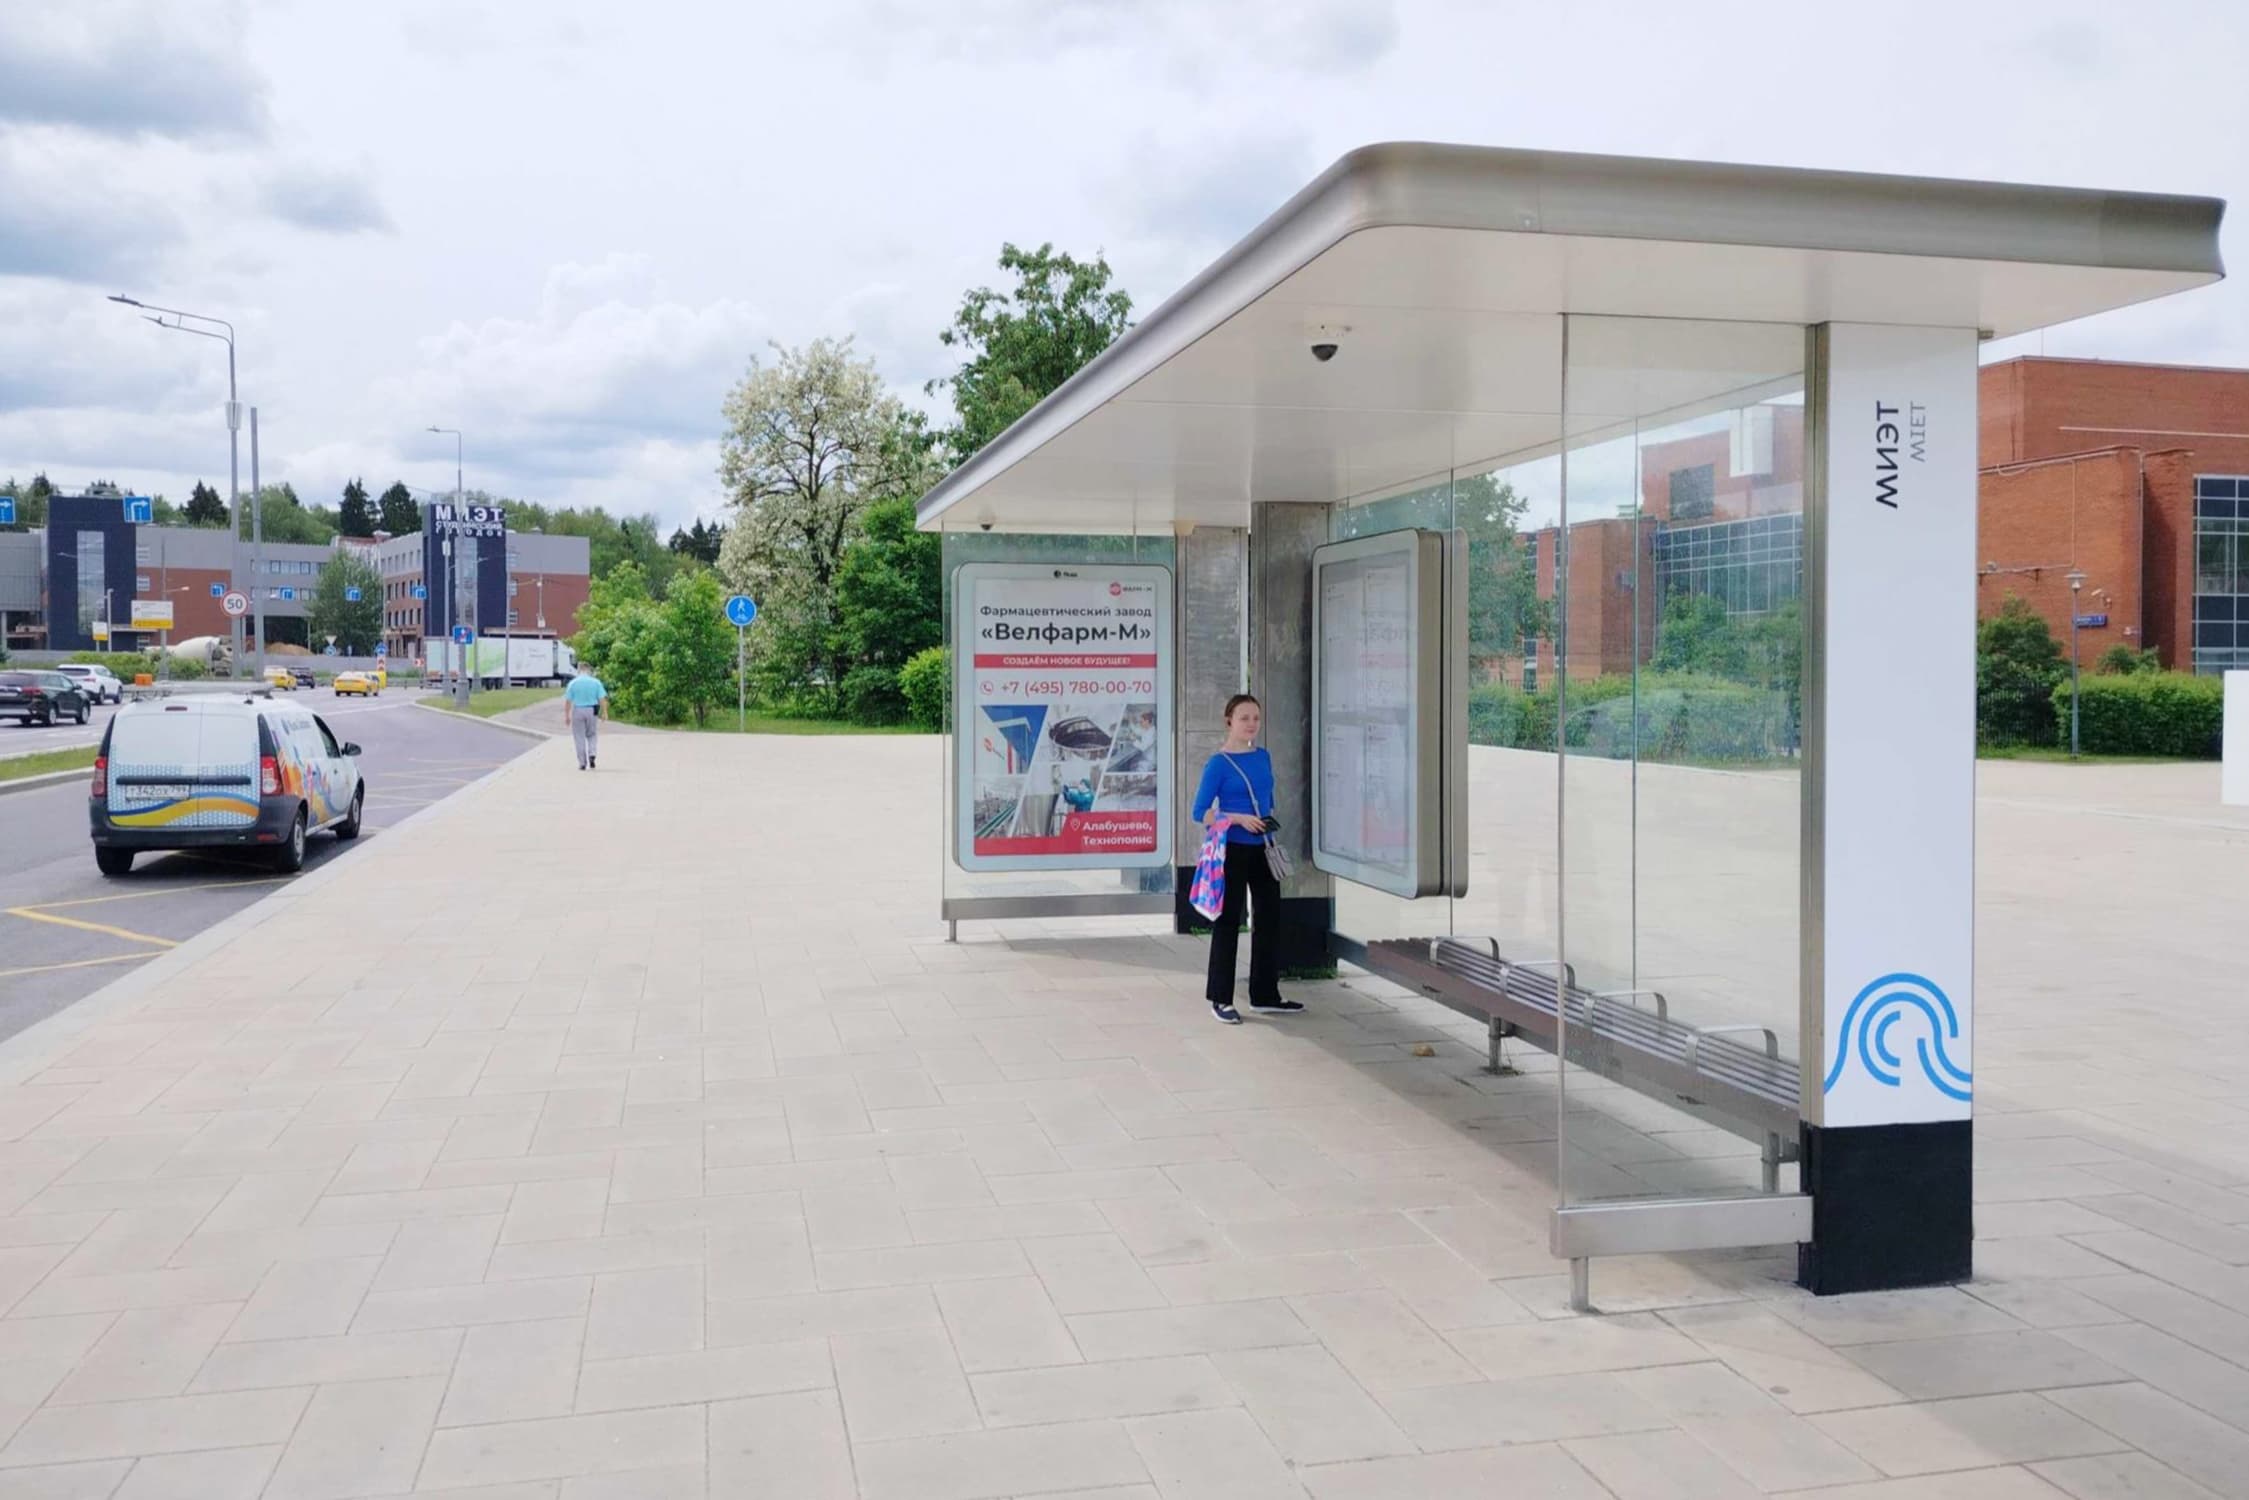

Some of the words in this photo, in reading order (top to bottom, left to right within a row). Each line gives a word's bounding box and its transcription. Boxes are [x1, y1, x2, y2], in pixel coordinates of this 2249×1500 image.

[1910, 400, 1926, 462] MIET
[1876, 400, 1899, 509] МИЭТ
[227, 599, 244, 610] 50
[980, 605, 1111, 618] Фармацевтический
[1115, 606, 1152, 618] завод
[981, 621, 1152, 645] «Велфарм-М»
[1003, 655, 1049, 666] СОЗДАЁМ
[1050, 656, 1081, 666] НОВОЕ
[1084, 655, 1131, 667] БУДУЩЕЕ!
[1002, 681, 1019, 694] +7
[1025, 681, 1064, 698] (495)
[1069, 680, 1152, 694] 780-00-70
[1083, 820, 1152, 833] Алабушево,
[1083, 835, 1152, 846] Технополис
